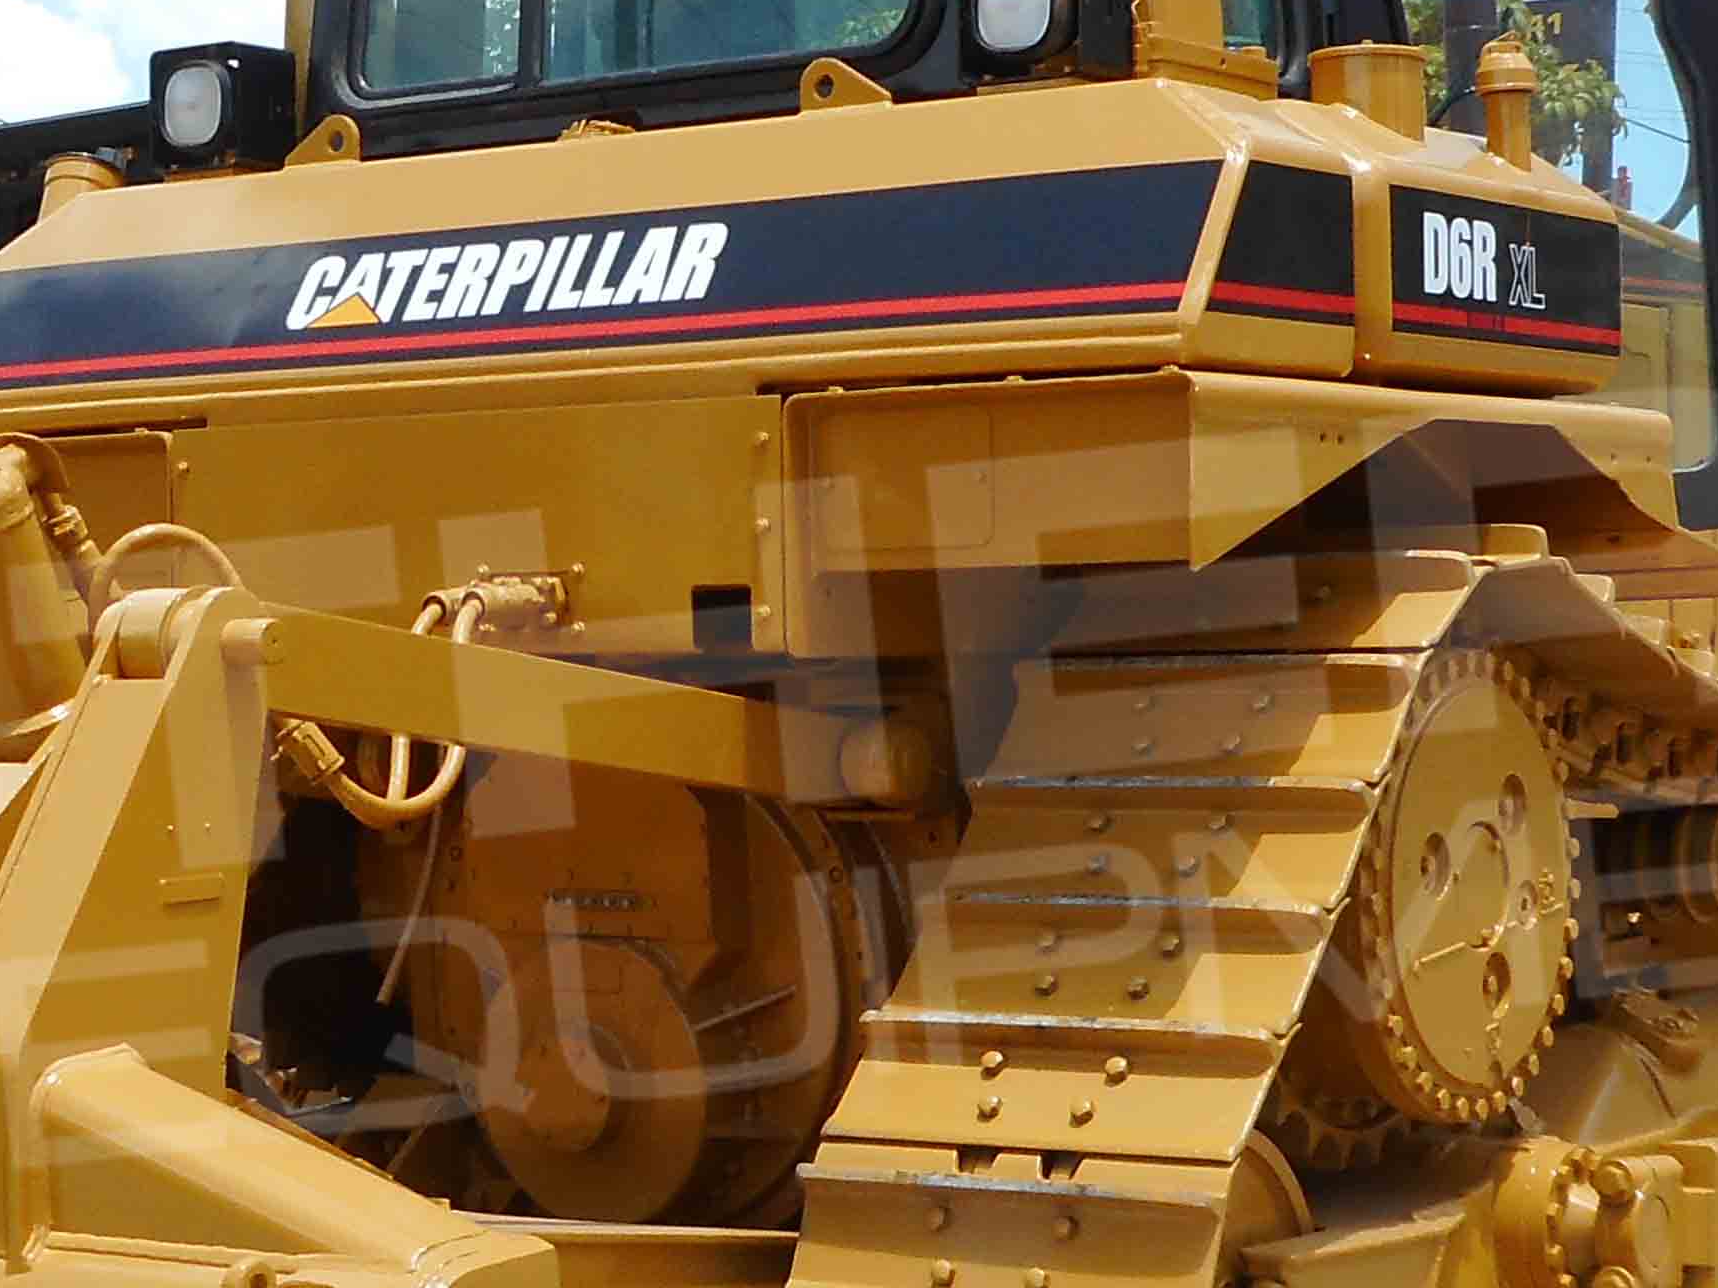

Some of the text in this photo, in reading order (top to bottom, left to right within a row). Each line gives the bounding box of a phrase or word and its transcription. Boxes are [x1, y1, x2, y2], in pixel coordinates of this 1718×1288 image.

[285, 223, 729, 331] CATERPILLAR
[1422, 211, 1546, 309] D6R XL
